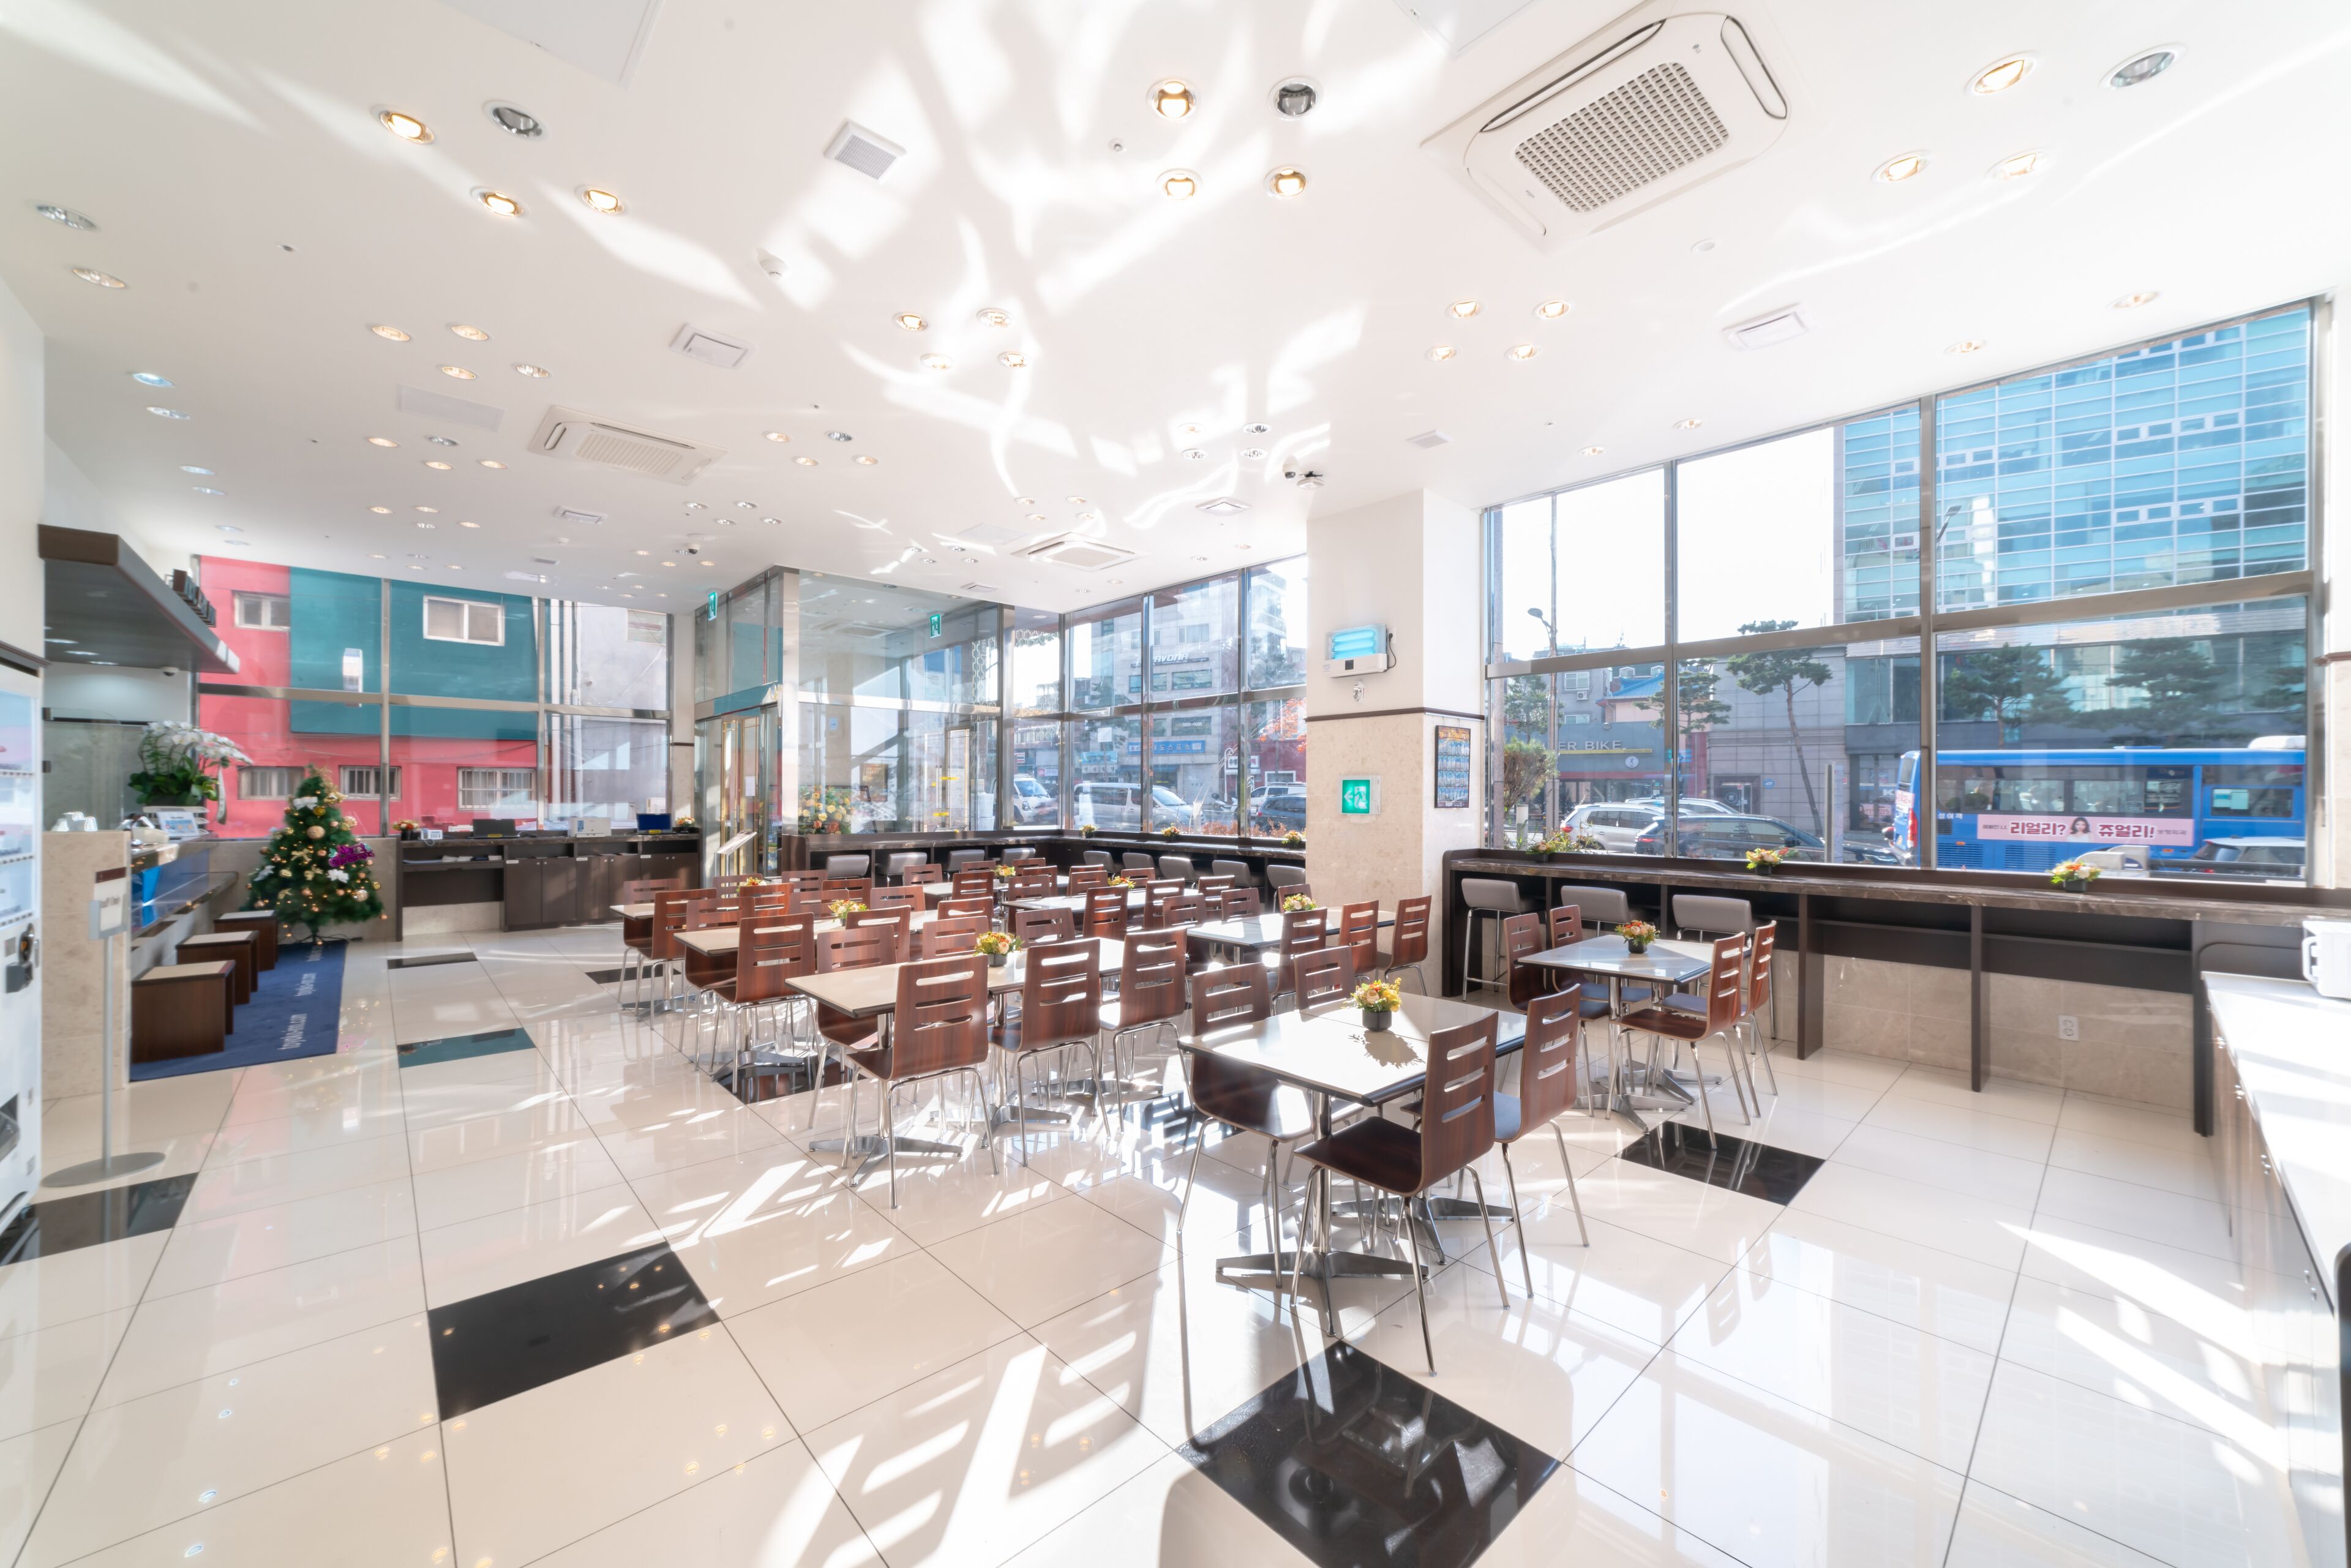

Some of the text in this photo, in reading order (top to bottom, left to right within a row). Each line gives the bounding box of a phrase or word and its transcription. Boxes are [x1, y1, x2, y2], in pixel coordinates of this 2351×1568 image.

[1584, 740, 1622, 751] BIKE
[2011, 822, 2066, 835] 리얼리?
[2099, 824, 2154, 838] 쥬얼리!
